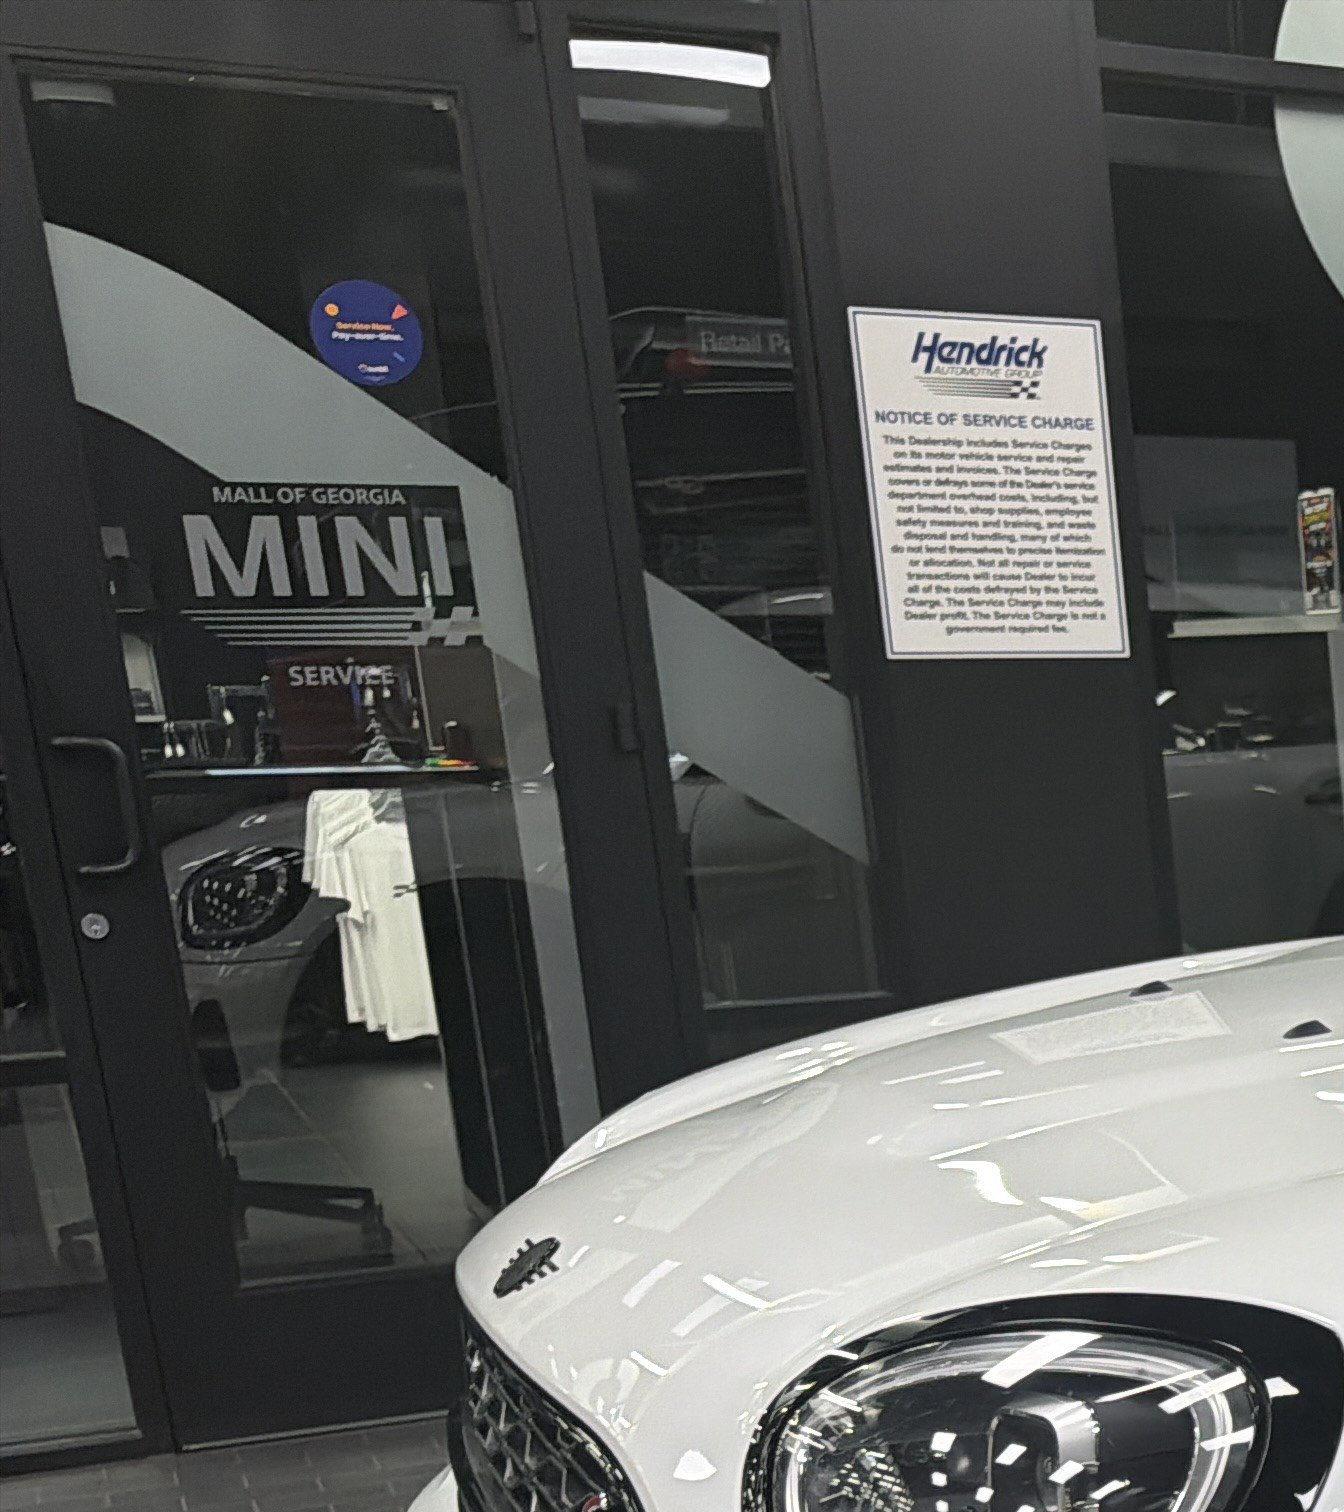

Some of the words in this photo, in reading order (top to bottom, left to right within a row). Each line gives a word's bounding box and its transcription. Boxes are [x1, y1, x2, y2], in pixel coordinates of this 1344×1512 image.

[911, 331, 1048, 373] Hendrick
[933, 365, 1002, 377] AUTOMOTIVE
[1004, 367, 1043, 379] GROUP
[874, 410, 933, 425] NOTICE
[936, 412, 958, 426] OF
[962, 413, 1027, 428] SERVICE
[1030, 415, 1095, 430] CHARGE
[882, 435, 905, 444] This
[1011, 439, 1048, 449] Service
[996, 452, 1032, 461] service
[1035, 453, 1053, 462] and
[934, 463, 954, 472] and
[1002, 465, 1021, 474] The
[1024, 466, 1059, 475] Service
[1062, 467, 1097, 479] Charge
[998, 478, 1008, 487] of
[1008, 479, 1023, 487] the
[1063, 480, 1094, 489] service
[212, 486, 274, 504] MALL
[276, 487, 307, 504] OF
[311, 487, 406, 505] GEORGIA
[896, 504, 914, 513] not
[981, 518, 1000, 527] and
[1045, 519, 1064, 528] and
[949, 531, 968, 540] and
[1049, 532, 1060, 541] of
[906, 544, 922, 552] not
[182, 514, 454, 598] MINI
[1055, 559, 1091, 568] service
[1024, 572, 1055, 580] Dealer
[921, 584, 932, 592] of
[934, 584, 950, 592] the
[1043, 585, 1059, 593] the
[1062, 585, 1098, 593] Service
[946, 597, 964, 606] The
[967, 597, 1005, 606] Service
[1007, 598, 1043, 608] Charge
[1045, 599, 1066, 608] may
[903, 611, 937, 619] Dealer
[972, 611, 991, 619] The
[993, 611, 1030, 619] Service
[1032, 611, 1068, 621] Charge
[1081, 611, 1098, 619] not
[288, 664, 396, 687] SERVICE
